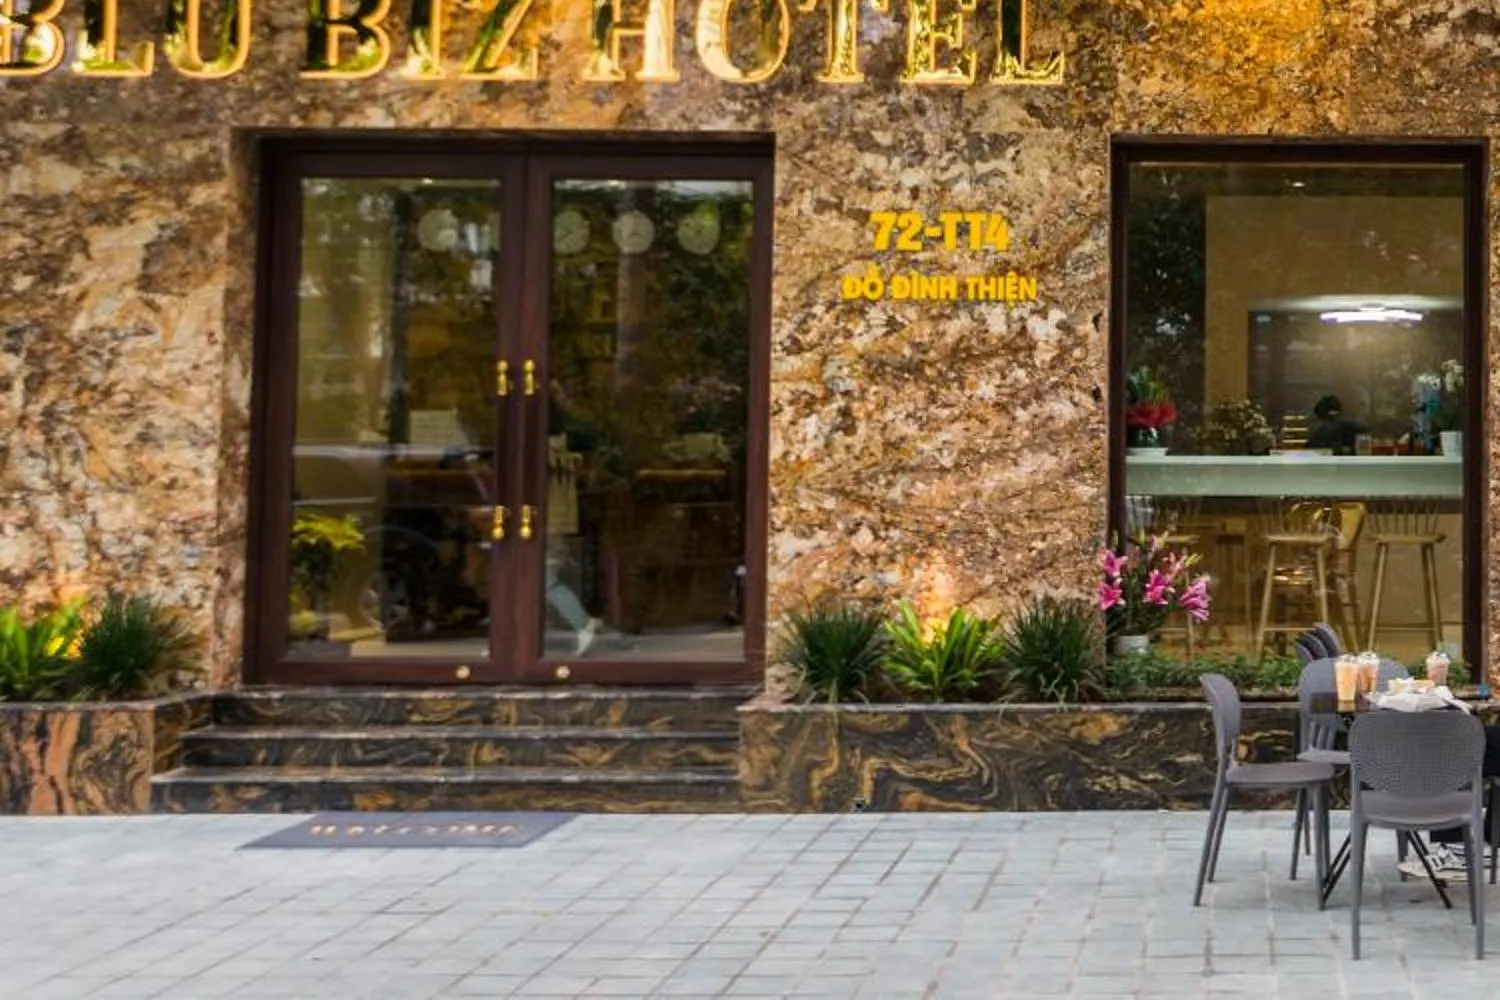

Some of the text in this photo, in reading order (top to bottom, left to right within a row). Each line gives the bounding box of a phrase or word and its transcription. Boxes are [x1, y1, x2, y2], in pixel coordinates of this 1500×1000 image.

[869, 210, 1010, 251] 72-TT4
[891, 268, 957, 300] ĐÌNH
[965, 270, 1037, 312] THIỆN
